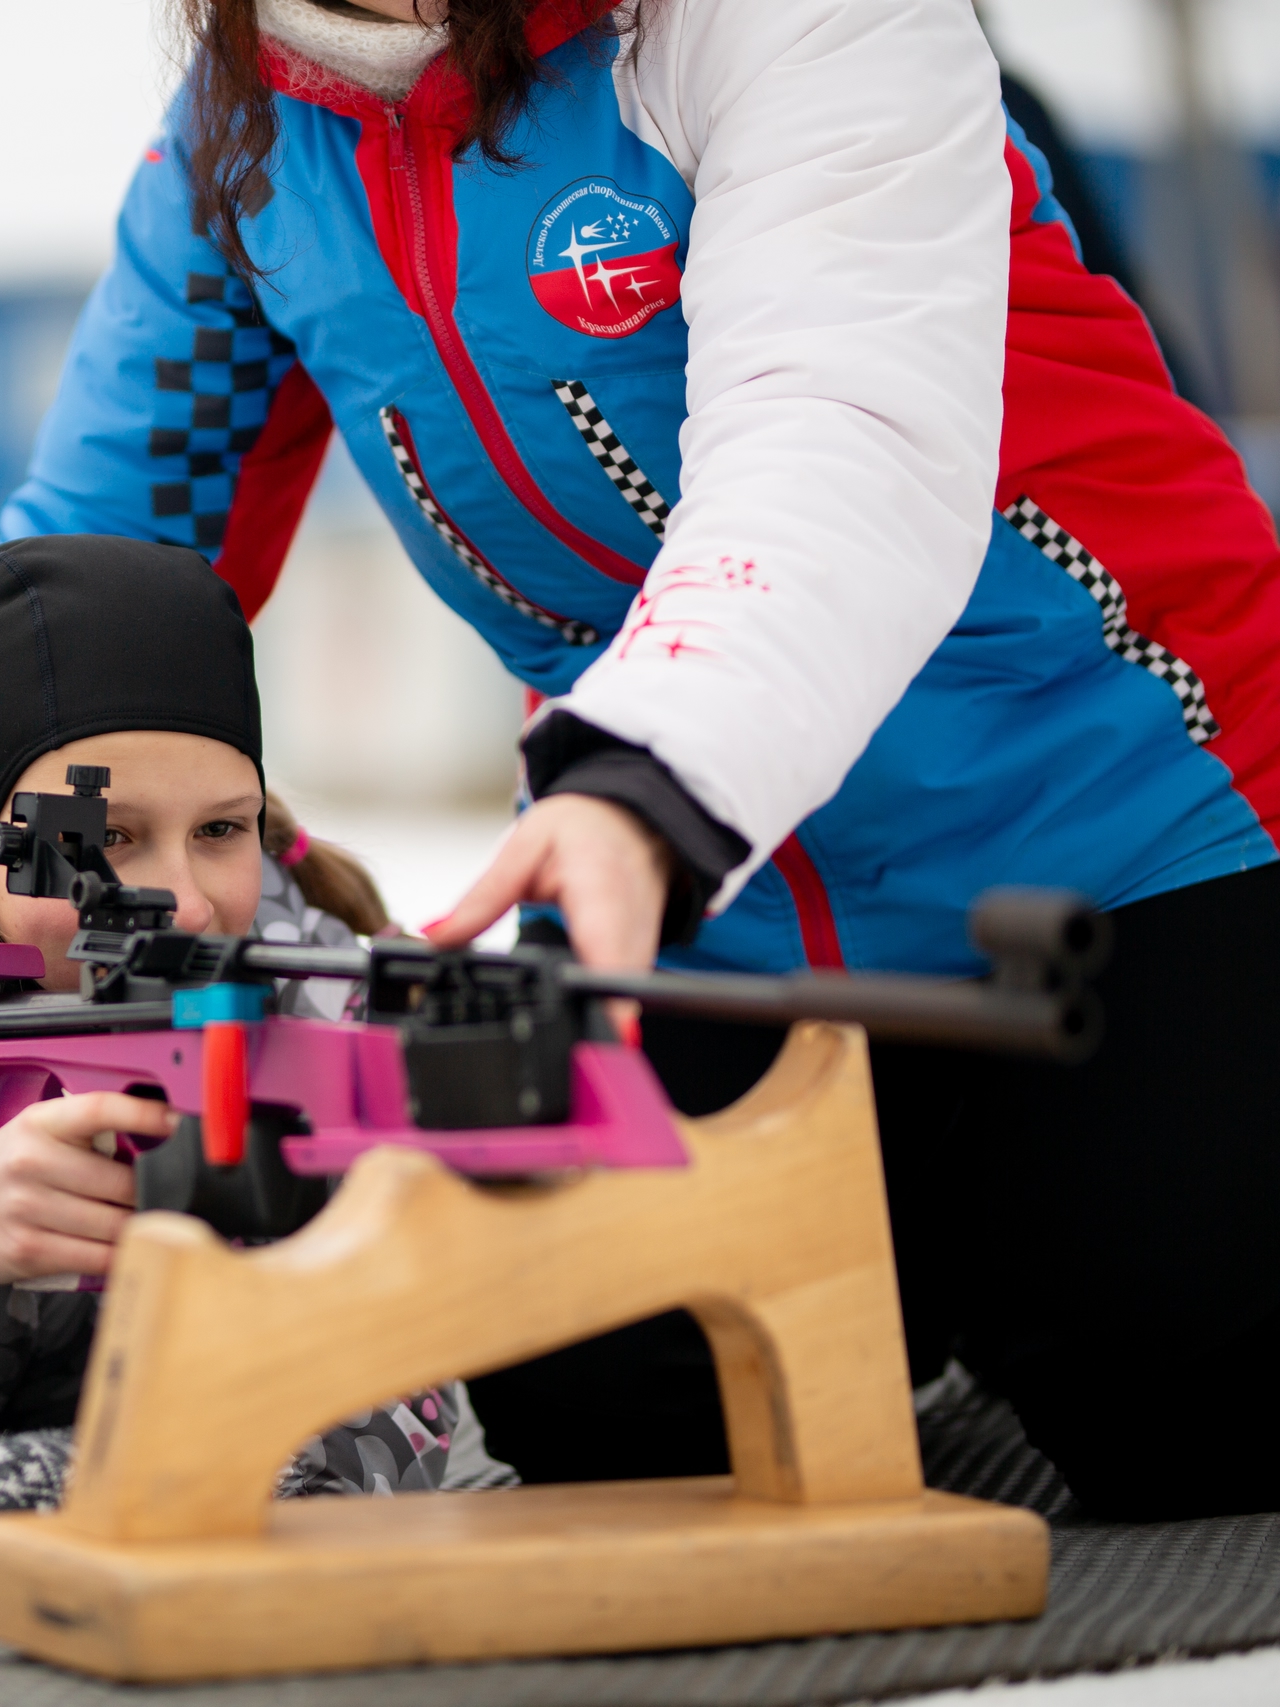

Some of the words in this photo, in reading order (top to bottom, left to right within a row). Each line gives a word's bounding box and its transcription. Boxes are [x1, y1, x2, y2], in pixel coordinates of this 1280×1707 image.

[533, 185, 588, 267] Детско-Юношеская
[588, 183, 645, 212] Спортивная
[644, 204, 671, 240] Школа
[576, 297, 666, 334] Краснознаменск
